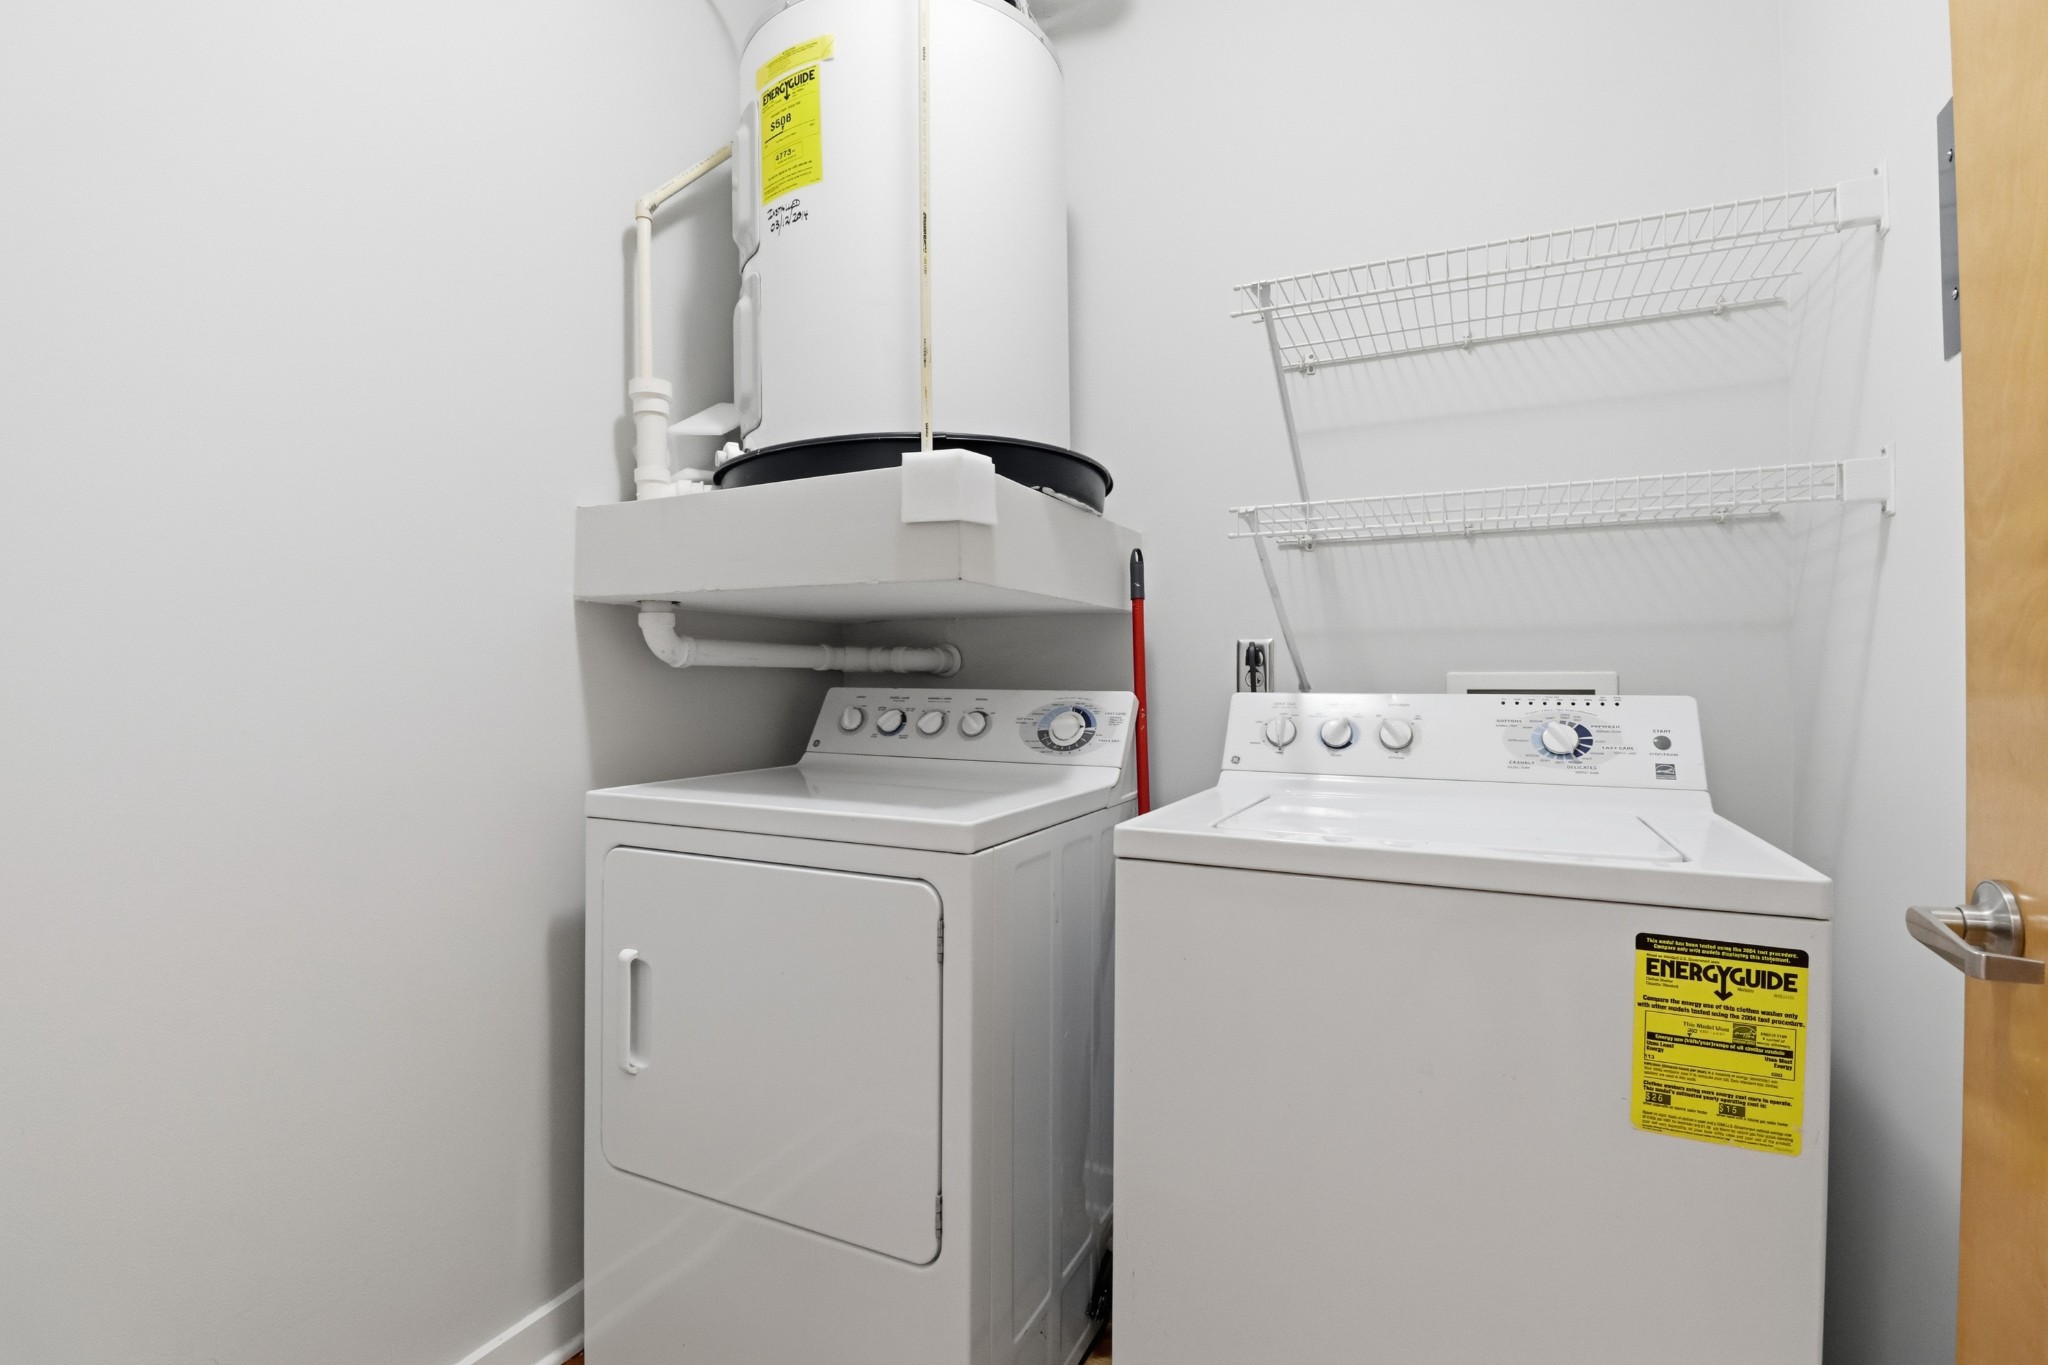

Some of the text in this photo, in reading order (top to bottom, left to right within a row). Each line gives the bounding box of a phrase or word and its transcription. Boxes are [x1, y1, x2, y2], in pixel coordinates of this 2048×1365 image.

[762, 69, 815, 107] ENERGYGUIDE
[775, 148, 792, 161] 4773
[1654, 944, 1676, 952] Compare
[1762, 955, 1791, 963] statement.
[1770, 950, 1799, 959] procedure.
[1646, 957, 1798, 993] ENERGYGUIDE
[1643, 995, 1669, 1004] Compare
[1681, 1000, 1702, 1008] energy
[1737, 1006, 1759, 1015] clothes
[1761, 1009, 1783, 1017] washer
[1785, 1012, 1798, 1020] only
[1668, 1005, 1690, 1013] models
[1691, 1008, 1710, 1016] tested
[1711, 1011, 1728, 1019] using
[1741, 1014, 1756, 1022] 2004
[1771, 1018, 1806, 1029] procedure.
[1774, 1063, 1792, 1071] Energy
[1769, 1099, 1792, 1108] operate.
